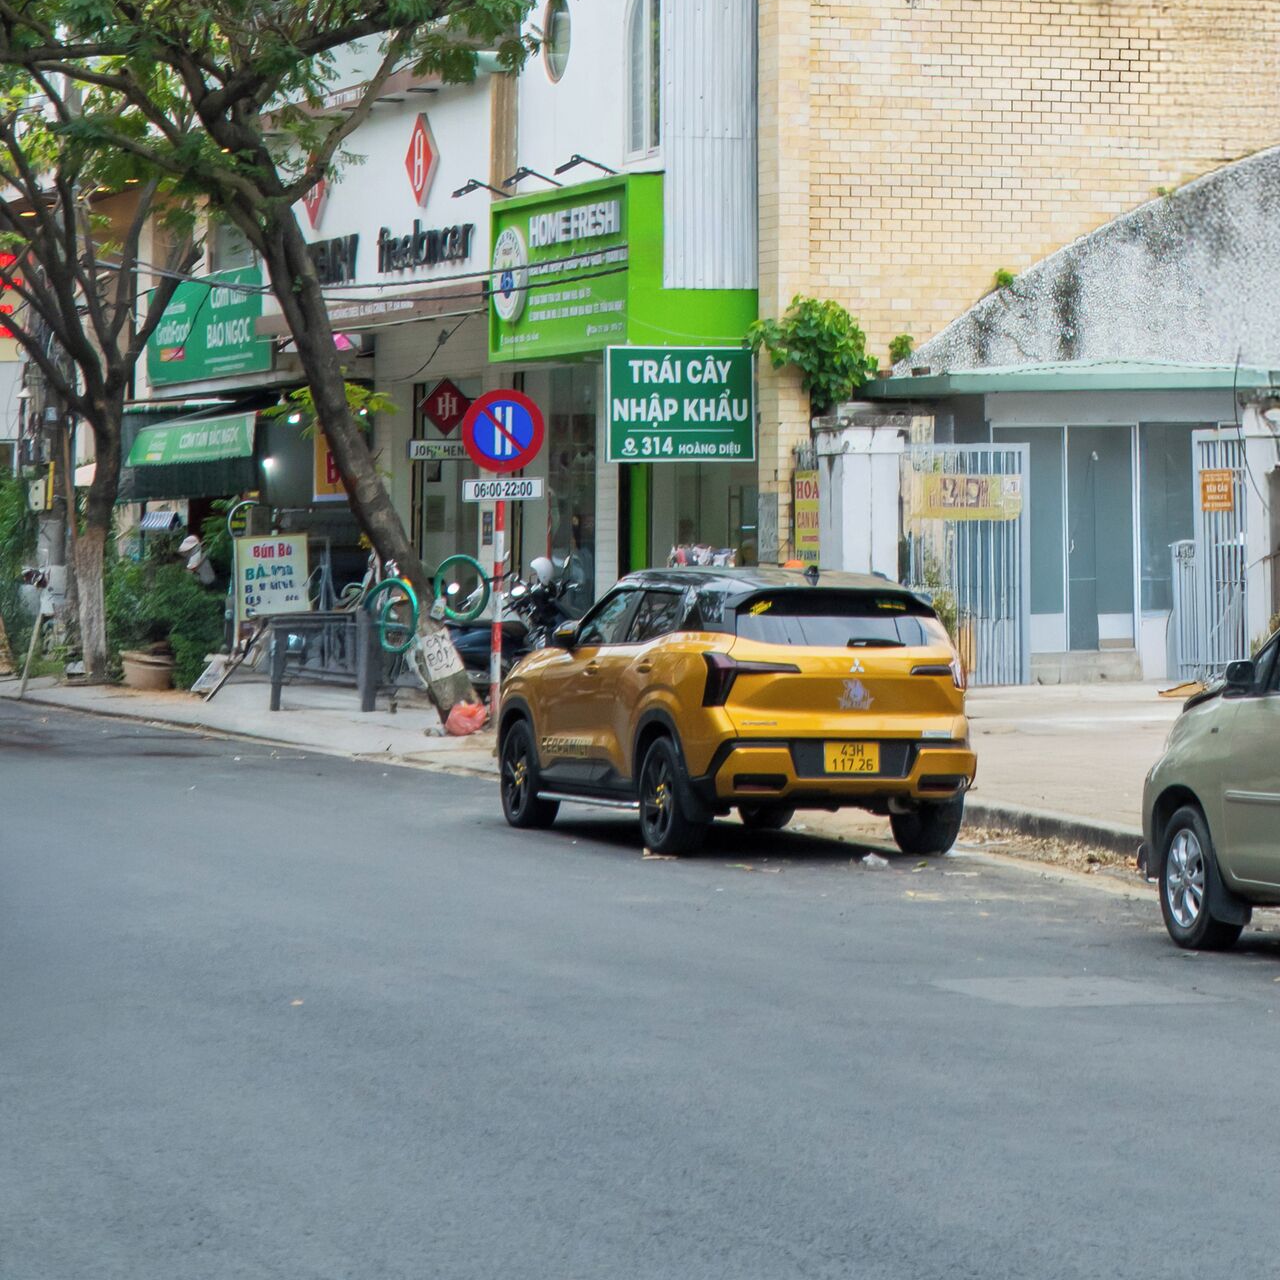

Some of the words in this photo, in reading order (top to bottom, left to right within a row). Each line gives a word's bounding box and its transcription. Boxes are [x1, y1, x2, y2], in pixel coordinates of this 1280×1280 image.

[628, 354, 681, 384] TRÁI
[687, 354, 732, 384] CÂY
[613, 393, 679, 428] NHẬP
[683, 389, 748, 421] KHẨU
[642, 436, 673, 455] 314
[678, 441, 717, 455] HOÀNG
[718, 441, 741, 456] DIỆU
[474, 481, 533, 498] 06:00-22:00
[841, 744, 864, 757] 43H
[833, 758, 874, 771] 117.26
